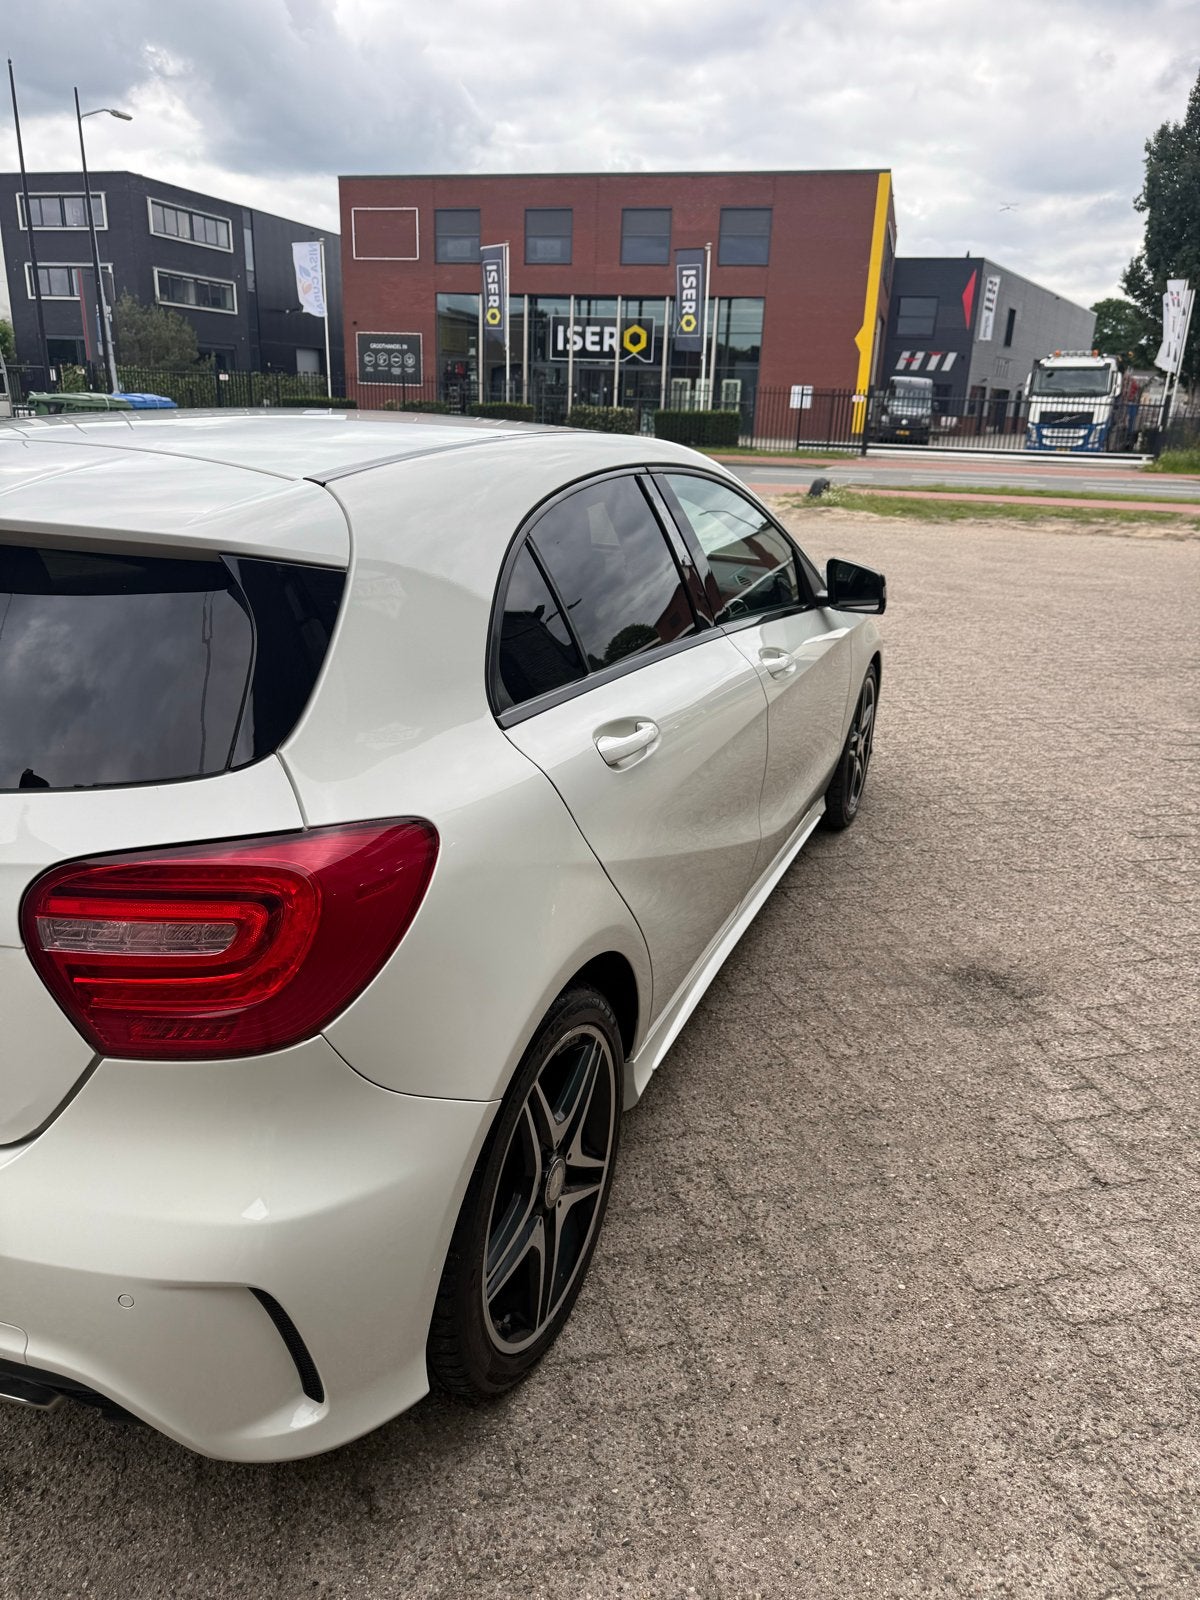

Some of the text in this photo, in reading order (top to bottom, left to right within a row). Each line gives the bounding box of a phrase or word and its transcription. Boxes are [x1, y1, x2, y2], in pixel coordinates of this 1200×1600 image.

[486, 265, 501, 325] ISERO
[682, 269, 697, 332] ISERO
[557, 325, 648, 354] ISERO
[895, 351, 958, 371] HTI
